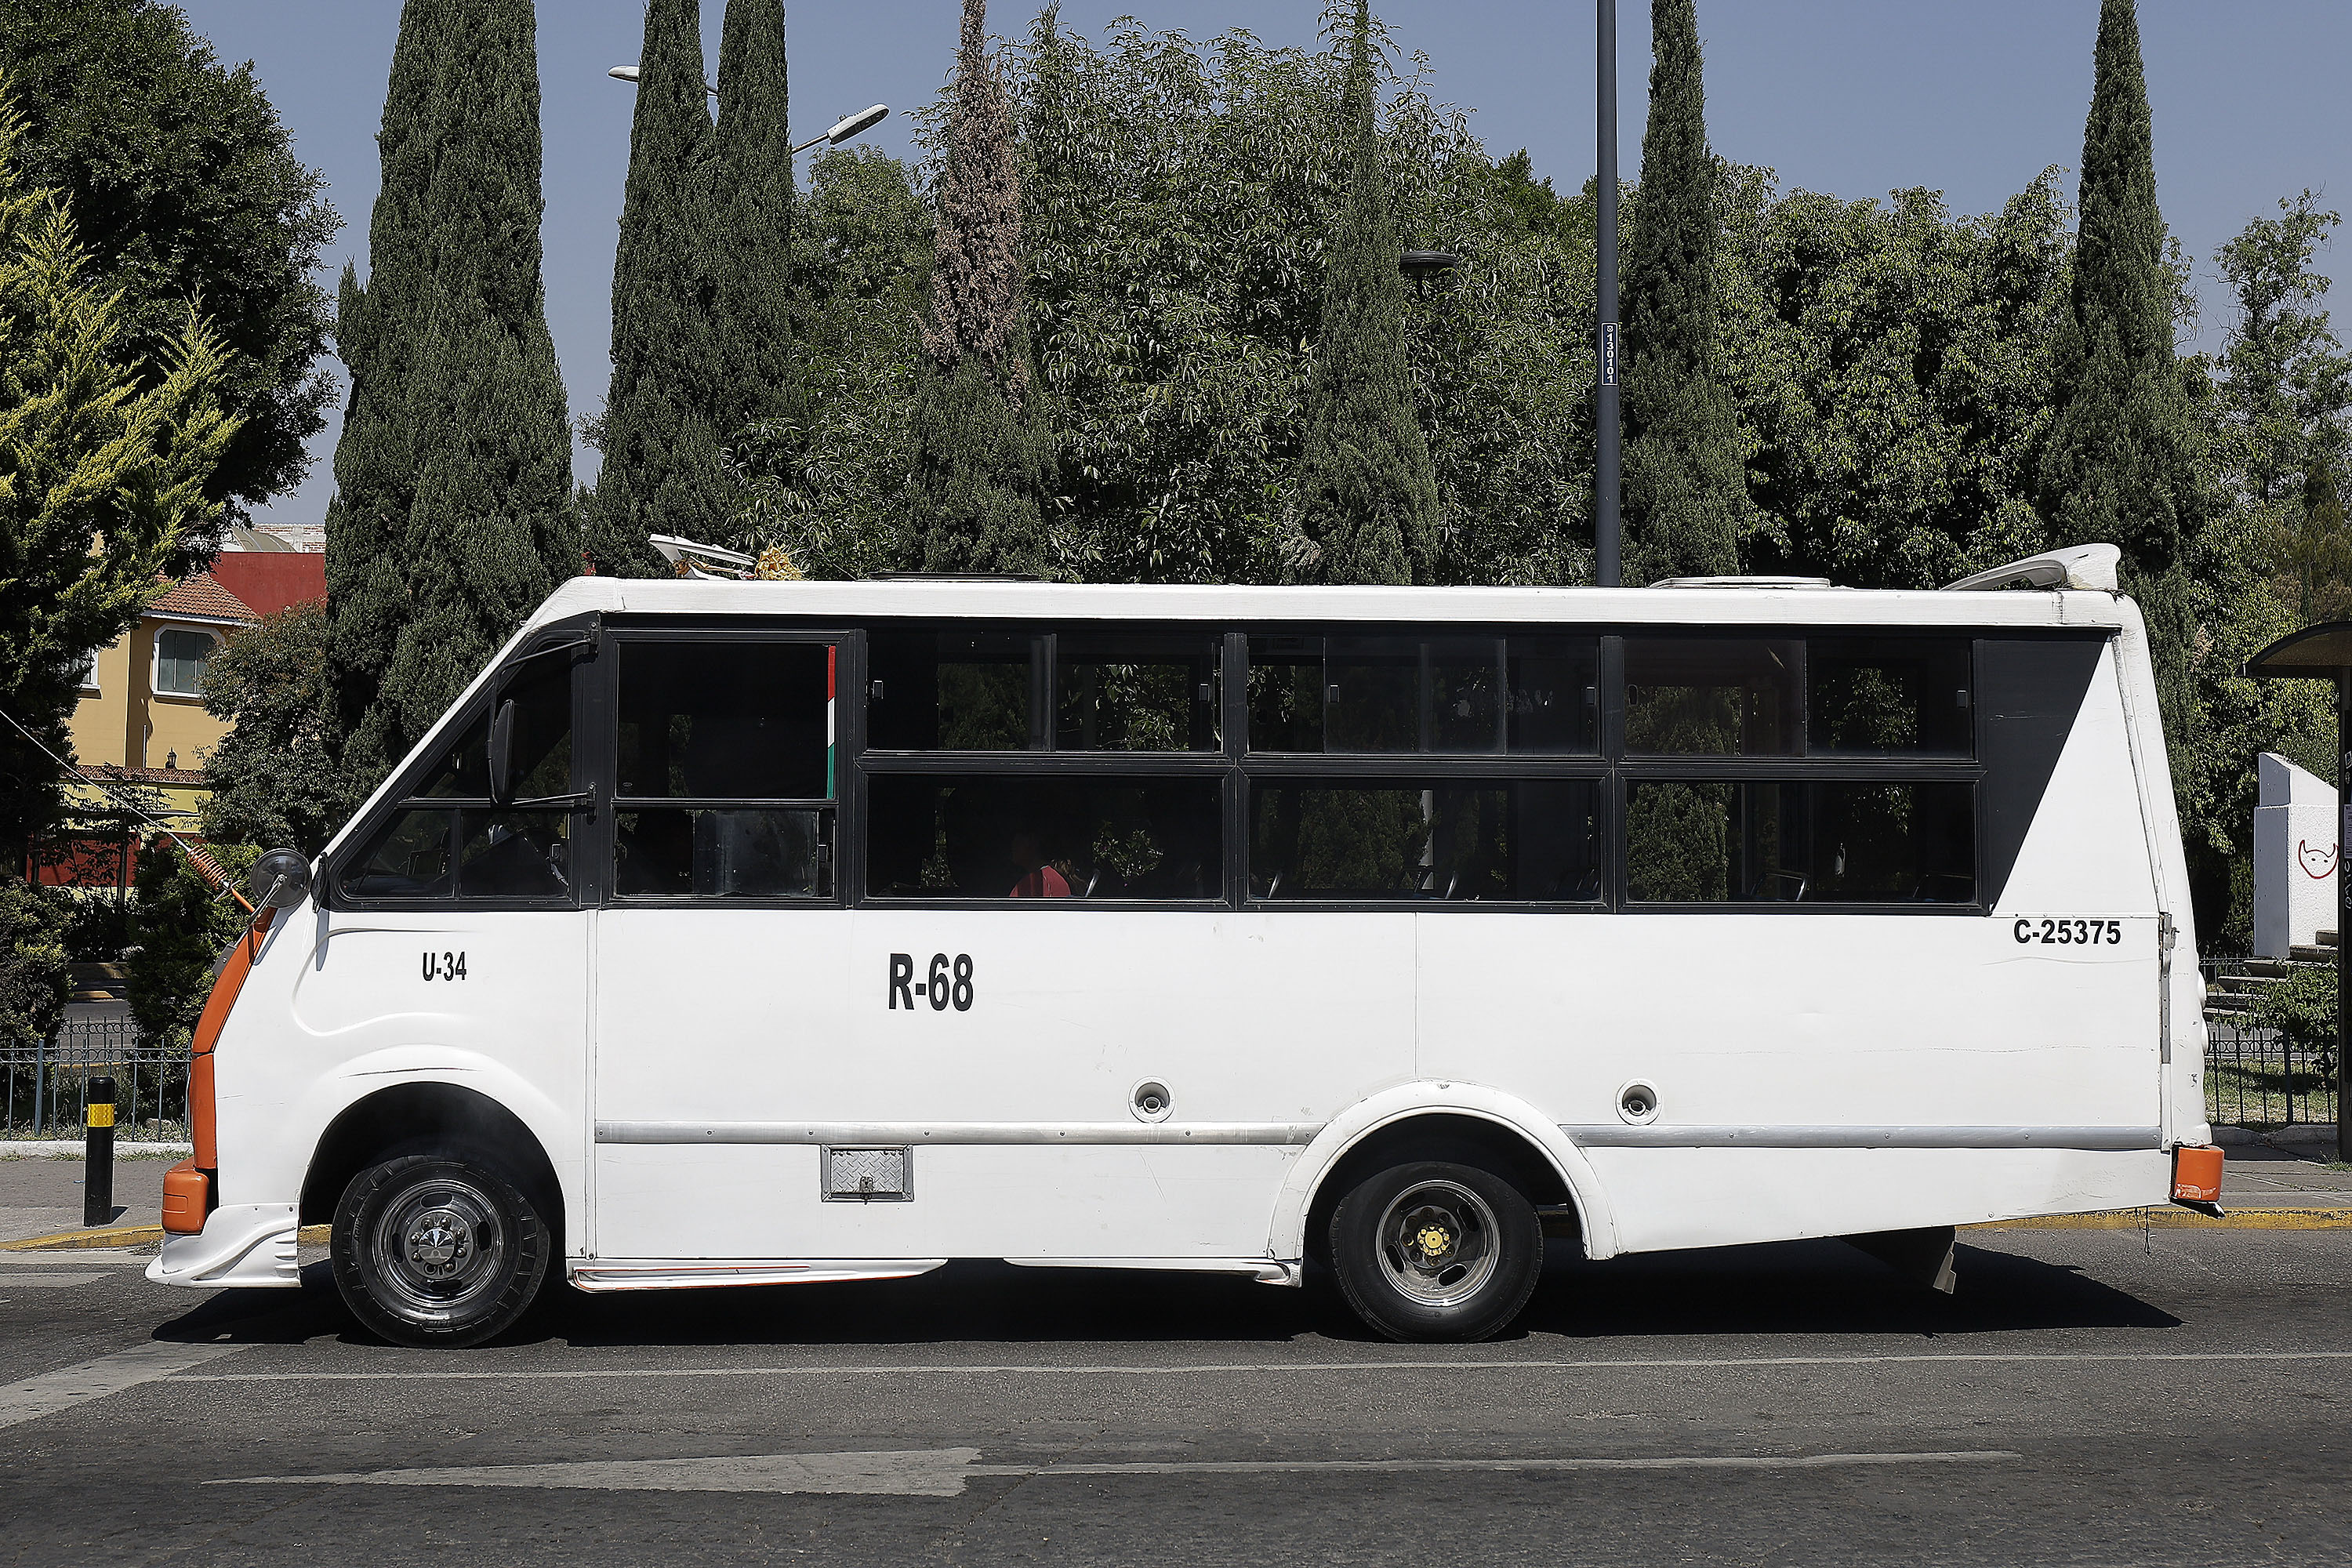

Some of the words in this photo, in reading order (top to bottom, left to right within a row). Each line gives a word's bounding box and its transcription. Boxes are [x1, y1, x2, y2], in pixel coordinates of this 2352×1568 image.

[2013, 919, 2122, 945] C-25375
[423, 951, 467, 982] U-34
[888, 953, 974, 1012] R-68
